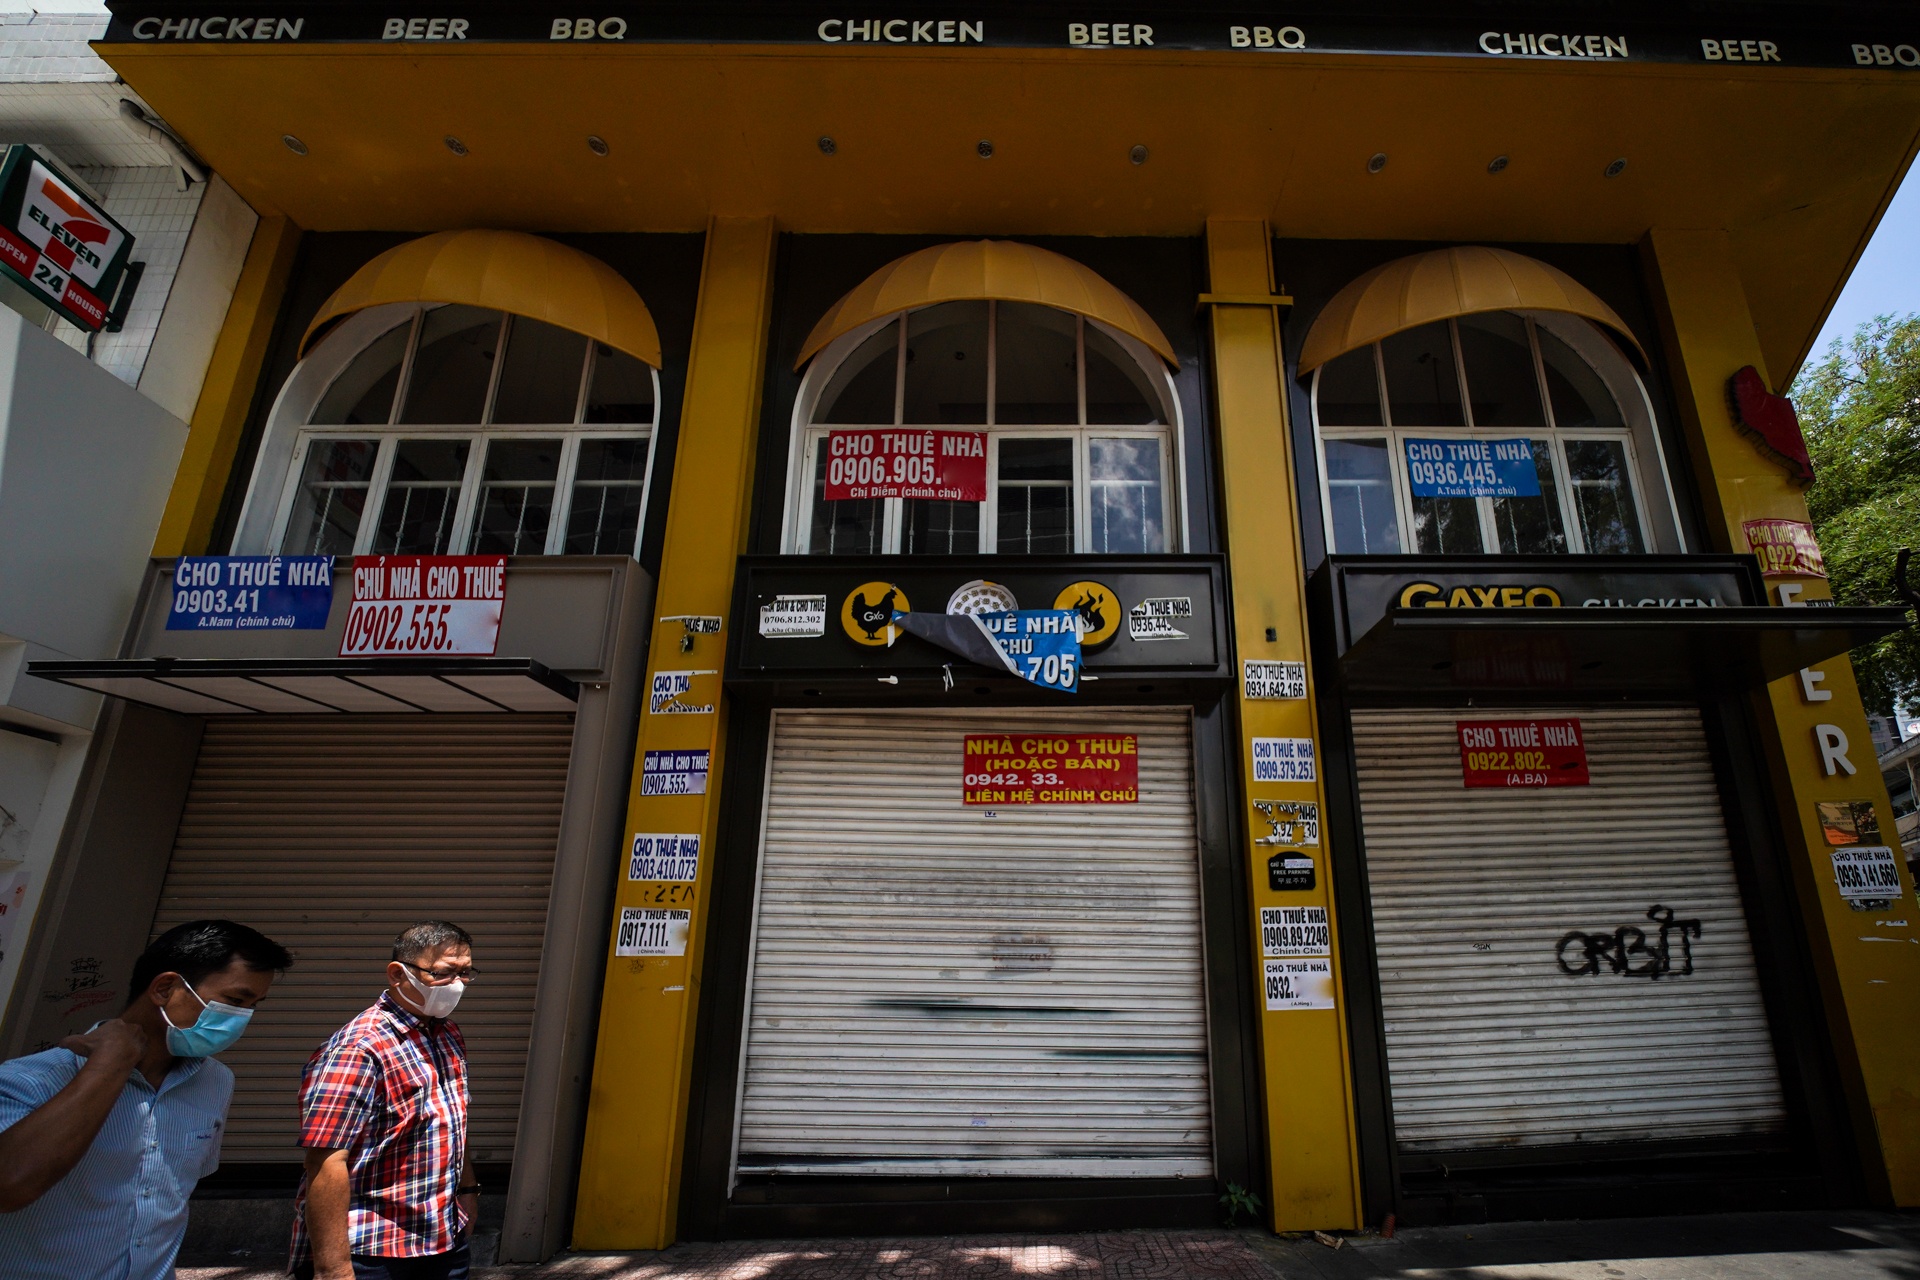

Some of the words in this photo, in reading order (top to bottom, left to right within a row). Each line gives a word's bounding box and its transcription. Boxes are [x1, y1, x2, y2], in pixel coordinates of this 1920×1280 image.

[132, 17, 304, 40] CHICKEN
[382, 18, 470, 40] BEER
[549, 17, 628, 41] BBQ
[817, 19, 984, 43] CHICKEN
[1068, 23, 1155, 46] BEER
[1230, 25, 1306, 49] BBQ
[1478, 31, 1629, 58] CHICKEN
[1701, 39, 1781, 62] BEER
[1851, 43, 1920, 67] BBQ
[0, 237, 28, 264] OPEN
[34, 263, 64, 294] 24
[67, 289, 102, 319] HOURS
[831, 434, 874, 456] CHO
[881, 430, 935, 455] THUÊ
[942, 432, 984, 457] NHÀ
[1408, 443, 1443, 461] CHO
[1447, 440, 1491, 461] THUÊ
[1495, 440, 1532, 460] NHÀ
[850, 487, 868, 499] Chị
[901, 486, 935, 498] (chính
[938, 487, 962, 500] chủ)
[1749, 525, 1772, 545] CHO
[176, 562, 220, 587] CHO
[228, 557, 282, 586] THUÊ
[288, 557, 330, 586] NHÀ
[354, 556, 385, 600] CHỦ
[389, 559, 421, 598] NHÀ
[427, 566, 459, 598] CHO
[464, 559, 504, 599] THUÊ
[175, 590, 259, 613] 0903.41
[790, 600, 796, 612] &
[796, 600, 809, 612] CHO
[198, 616, 233, 627] A.Nam
[236, 616, 269, 628] (chính
[272, 615, 296, 628] chủ)
[764, 615, 821, 625] 0706.812.302
[1026, 611, 1077, 634] NHÀ
[1245, 664, 1262, 680] CHO
[1264, 662, 1284, 680] THUÊ
[1286, 662, 1303, 681] NHÀ
[654, 676, 672, 692] CHO
[1246, 681, 1304, 697] 0931.642.166
[966, 735, 1015, 755] NHÀ
[1021, 739, 1069, 755] CHO
[1076, 736, 1137, 755] THUÊ
[1462, 727, 1496, 748] CHO
[1498, 722, 1541, 748] THUÊ
[1543, 722, 1579, 747] NHÀ
[1254, 742, 1271, 758] CHO
[1273, 739, 1294, 758] THUÊ
[1297, 740, 1314, 758] NHÀ
[644, 751, 659, 771] CHỦ
[659, 753, 674, 771] NHÀ
[676, 756, 690, 770] CHO
[691, 753, 710, 770] THUÊ
[985, 756, 1058, 772] (HOẶC
[1065, 756, 1121, 772] BÁN)
[1256, 760, 1314, 780] 0909.379.251
[965, 773, 1024, 786] 0942.
[1507, 773, 1548, 786] (A.BA)
[966, 789, 1005, 803] LIÊN
[1010, 788, 1035, 804] HỆ
[1039, 787, 1095, 803] CHÍNH
[1100, 786, 1137, 802] CHỦ
[633, 838, 653, 857] CHO
[655, 835, 679, 857] THUÊ
[679, 835, 699, 857] NHÀ
[1851, 850, 1873, 861] THUÊ
[1875, 849, 1892, 860] NHÀ
[629, 858, 696, 880] 0903.410.073
[1836, 864, 1899, 888] 0936.141.660
[623, 910, 642, 921] CHO
[644, 909, 667, 920] THUÊ
[1262, 910, 1282, 925] CHO
[1283, 907, 1307, 925] THUÊ
[1307, 907, 1327, 924] NHÀ
[1263, 926, 1329, 947] 0909.89.2248
[1272, 947, 1300, 955] Chính
[1266, 964, 1284, 973] CHO
[1286, 962, 1308, 972] THUÊ
[1310, 962, 1328, 972] NHÀ
